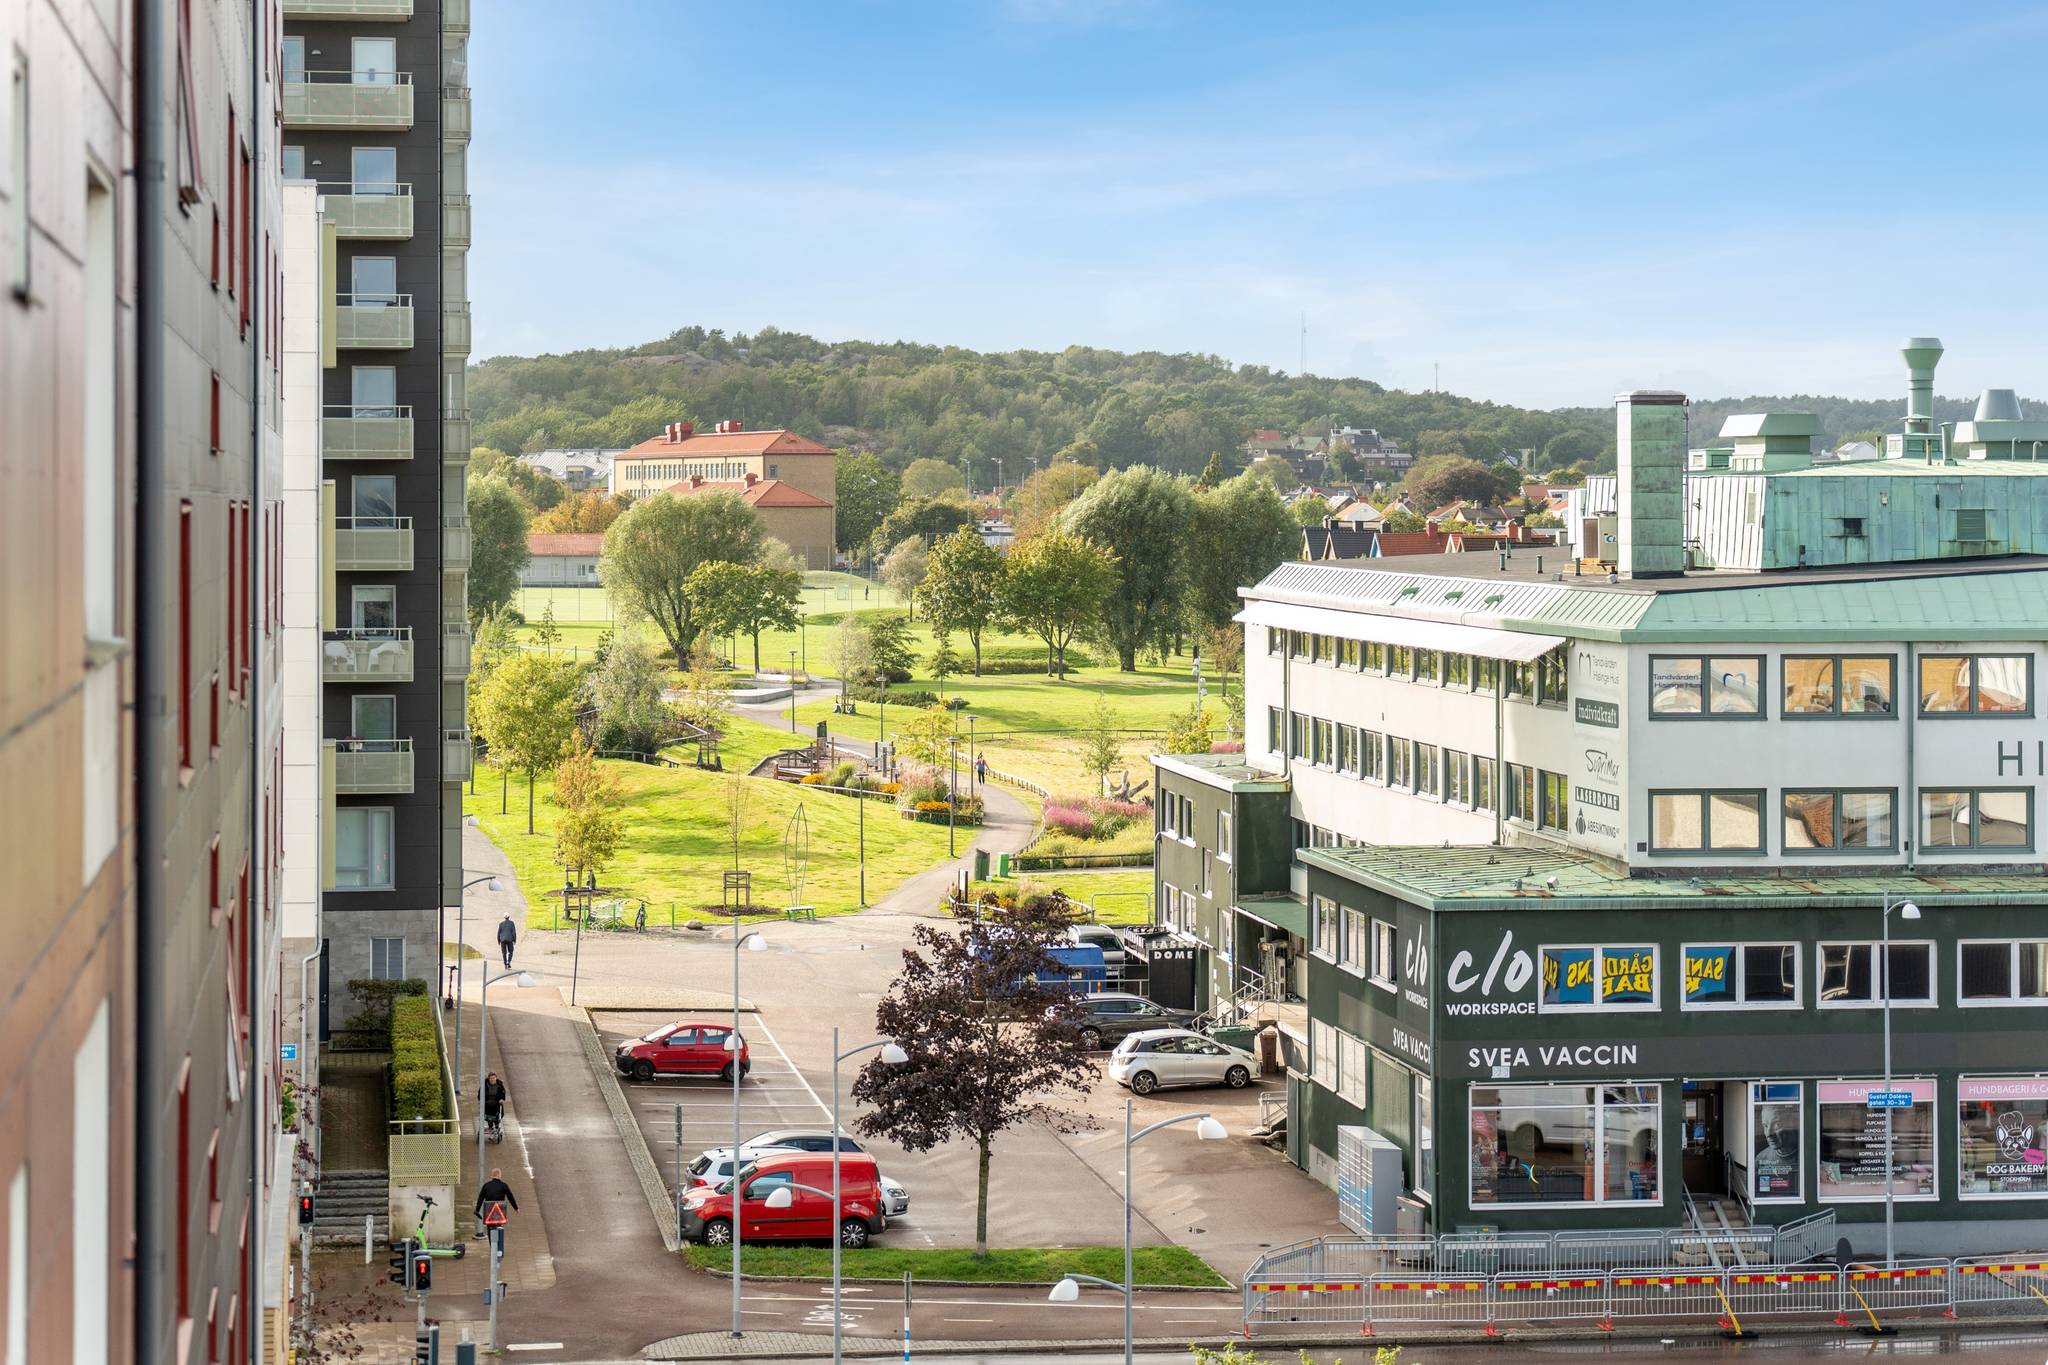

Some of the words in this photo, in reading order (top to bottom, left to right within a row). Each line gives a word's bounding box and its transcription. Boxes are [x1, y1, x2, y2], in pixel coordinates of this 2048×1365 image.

[1653, 673, 1699, 681] Tandvården
[1578, 703, 1617, 724] individkraft
[1576, 787, 1617, 810] LASERDOME
[1153, 950, 1194, 960] DOME
[1447, 930, 1534, 997] c/o
[1405, 989, 1428, 1010] WORKSPACE
[1446, 1002, 1536, 1016] WORKSPACE
[1392, 1027, 1408, 1053] SVEA
[1409, 1036, 1431, 1065] VACCI
[1468, 1047, 1530, 1068] SVEA
[1538, 1045, 1637, 1066] VACCIN
[1968, 1085, 2029, 1095] HUNDBAGERI
[1986, 1164, 2008, 1174] DOG
[2009, 1164, 2045, 1174] BAKERY
